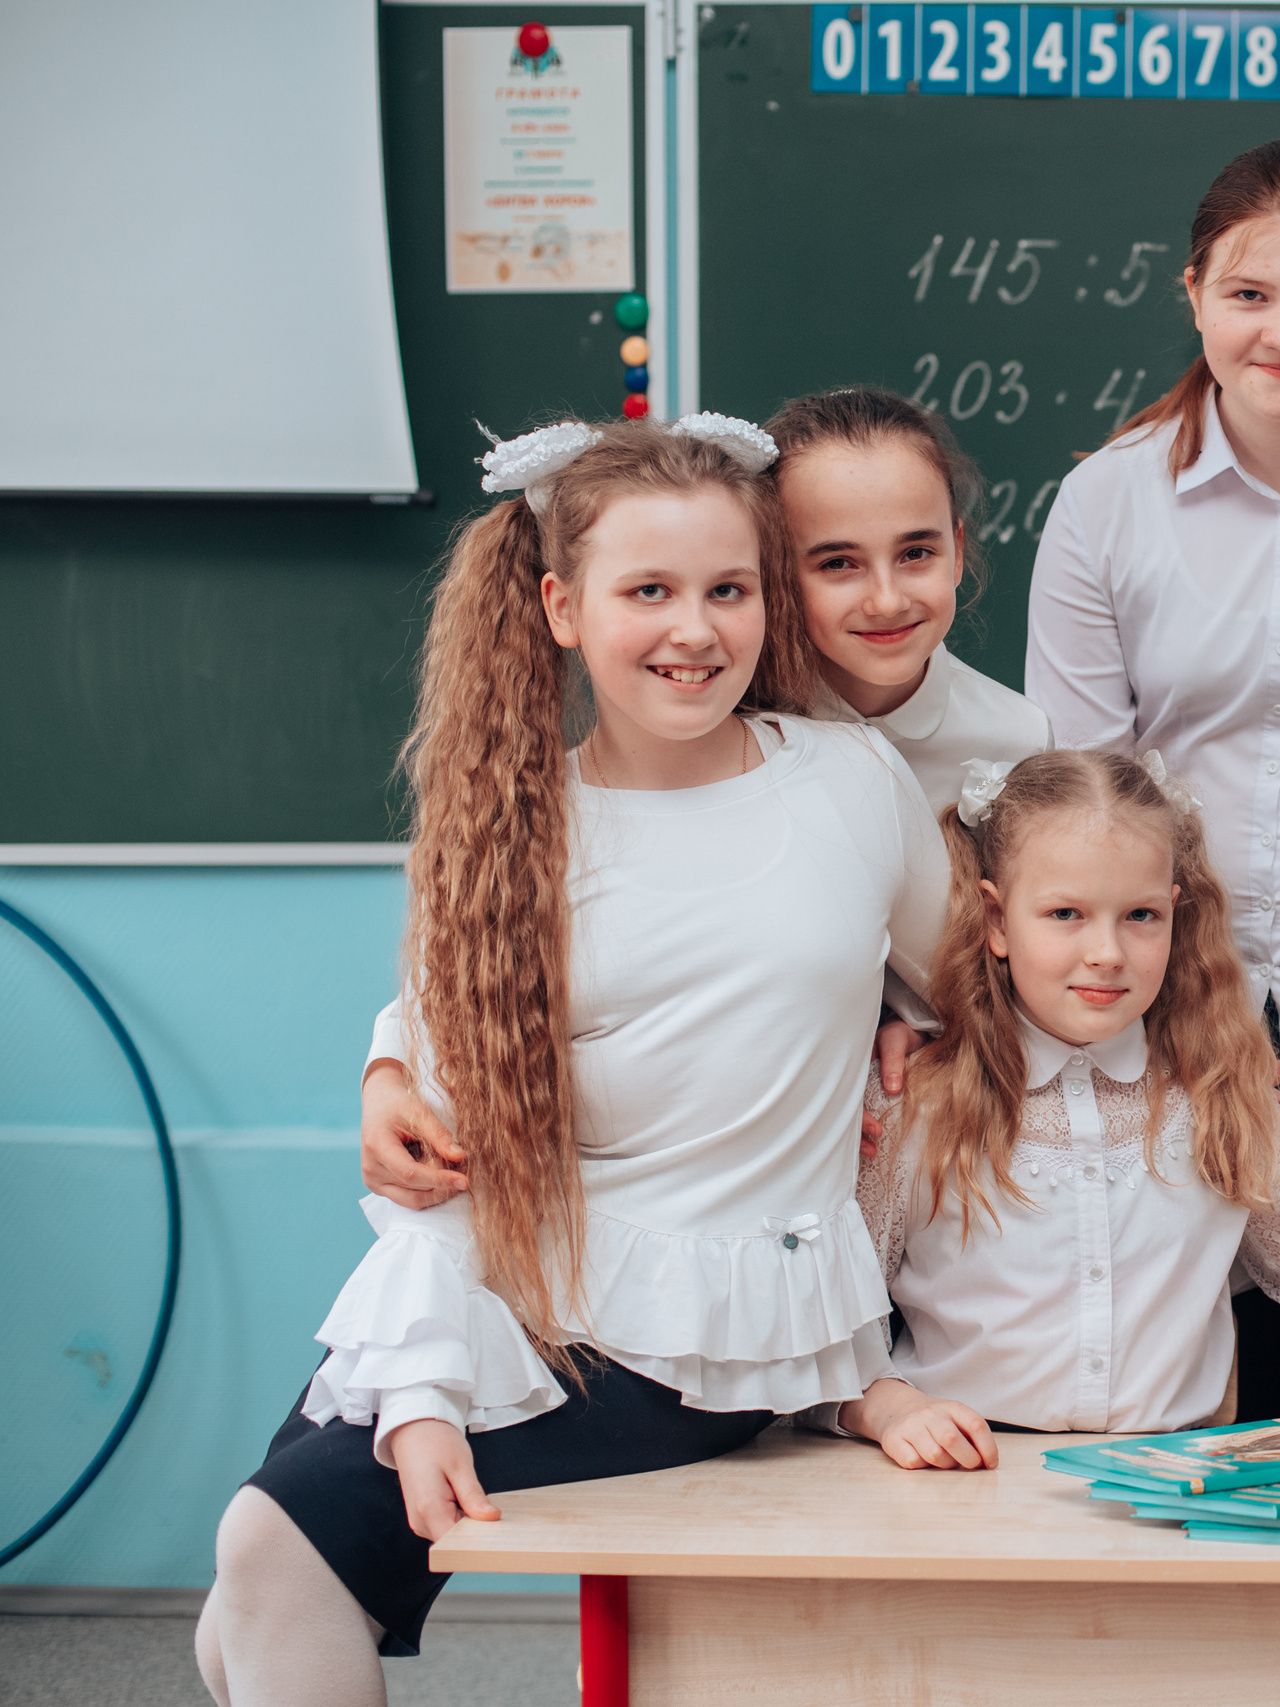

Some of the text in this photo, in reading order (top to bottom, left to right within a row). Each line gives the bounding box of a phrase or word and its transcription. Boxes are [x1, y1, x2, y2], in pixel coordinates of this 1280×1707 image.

[822, 18, 856, 80] 0
[878, 20, 901, 80] 1
[928, 20, 959, 81] 2
[981, 20, 1011, 82] 3
[1033, 22, 1067, 82] 4
[1087, 23, 1117, 84] 5
[1138, 24, 1172, 85] 6
[1193, 26, 1224, 85] 7
[1245, 26, 1277, 87] 8
[908, 234, 1060, 304] 145
[911, 353, 1029, 424] 203
